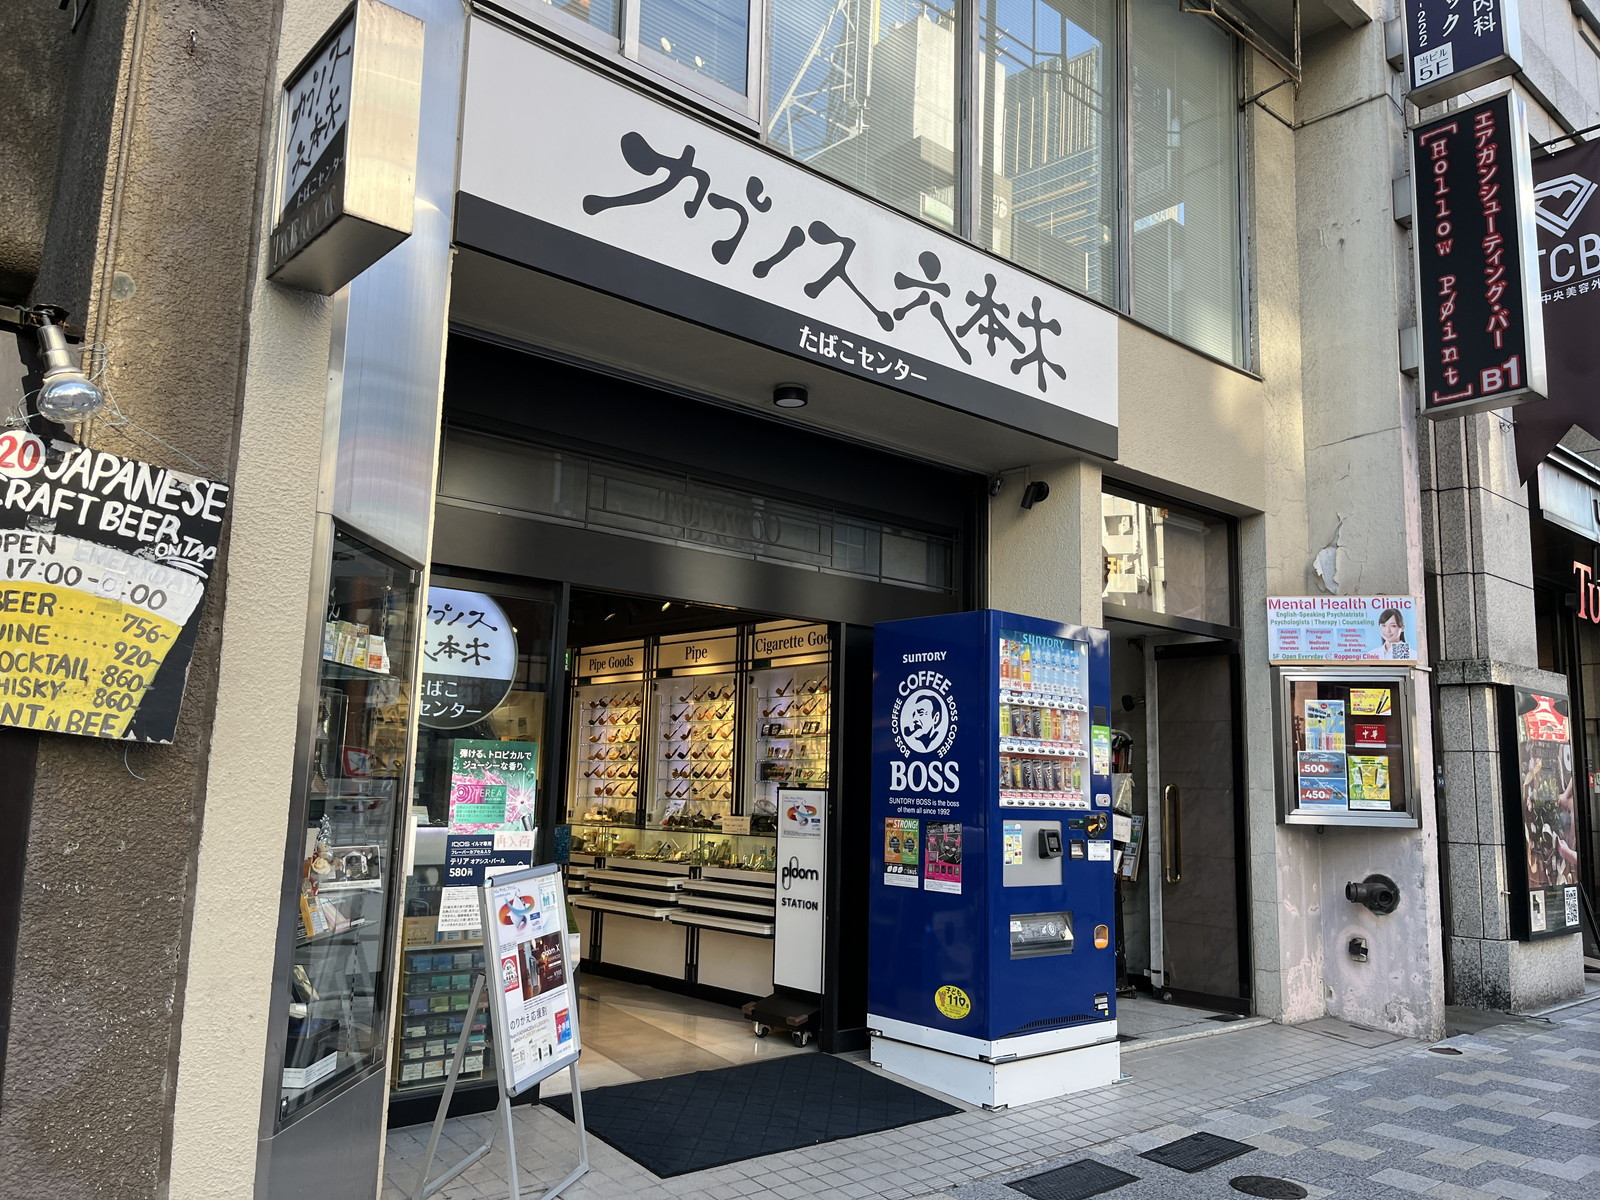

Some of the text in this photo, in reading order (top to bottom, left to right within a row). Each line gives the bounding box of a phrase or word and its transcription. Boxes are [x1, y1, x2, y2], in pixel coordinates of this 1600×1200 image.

[1419, 48, 1448, 66] 当ビル
[1420, 58, 1449, 81] 5F
[291, 85, 342, 187] 六本木
[295, 157, 345, 208] たばこセンター
[1474, 110, 1511, 349] エアガンシューティング・バー
[1538, 233, 1600, 283] CB
[799, 325, 928, 382] たばこセンター
[1480, 354, 1520, 394] B1
[0, 435, 229, 522] 20 JAPANESE
[0, 473, 181, 543] RAFT BEER
[0, 533, 56, 555] PEN
[155, 535, 217, 562] ON TAP
[1267, 597, 1412, 611] Mental Health Clinic
[427, 603, 499, 632] プノス
[1270, 619, 1375, 627] Psychologists Therapy Counseling
[1276, 611, 1365, 619] English-Speaking Psychiatrists
[755, 634, 805, 655] Cigarette
[1022, 633, 1065, 649] SUNTORY
[588, 655, 635, 673] Pipe Goods
[685, 646, 708, 663] Pipe
[902, 651, 947, 663] SUNTORY
[1298, 653, 1324, 661] Everyday
[1333, 653, 1362, 661] Roppongi
[898, 670, 952, 696] COFFEE
[891, 698, 911, 758] BOSS COFFEE
[937, 695, 959, 759] BOSS COFFEE
[459, 748, 532, 761] 弾ける、トロピカルで
[462, 759, 527, 772] ジューシーな香り。
[889, 760, 960, 793] BOSS
[475, 788, 503, 798] TEREA
[889, 797, 915, 805] SUNTORY
[915, 798, 932, 806] BOSS
[937, 799, 946, 807] the
[946, 799, 960, 807] boss
[903, 806, 915, 814] them
[450, 857, 470, 866] テリア
[449, 867, 474, 877] 580円
[782, 856, 819, 890] ploom
[781, 897, 819, 911] STATION
[945, 986, 962, 997] 子ども
